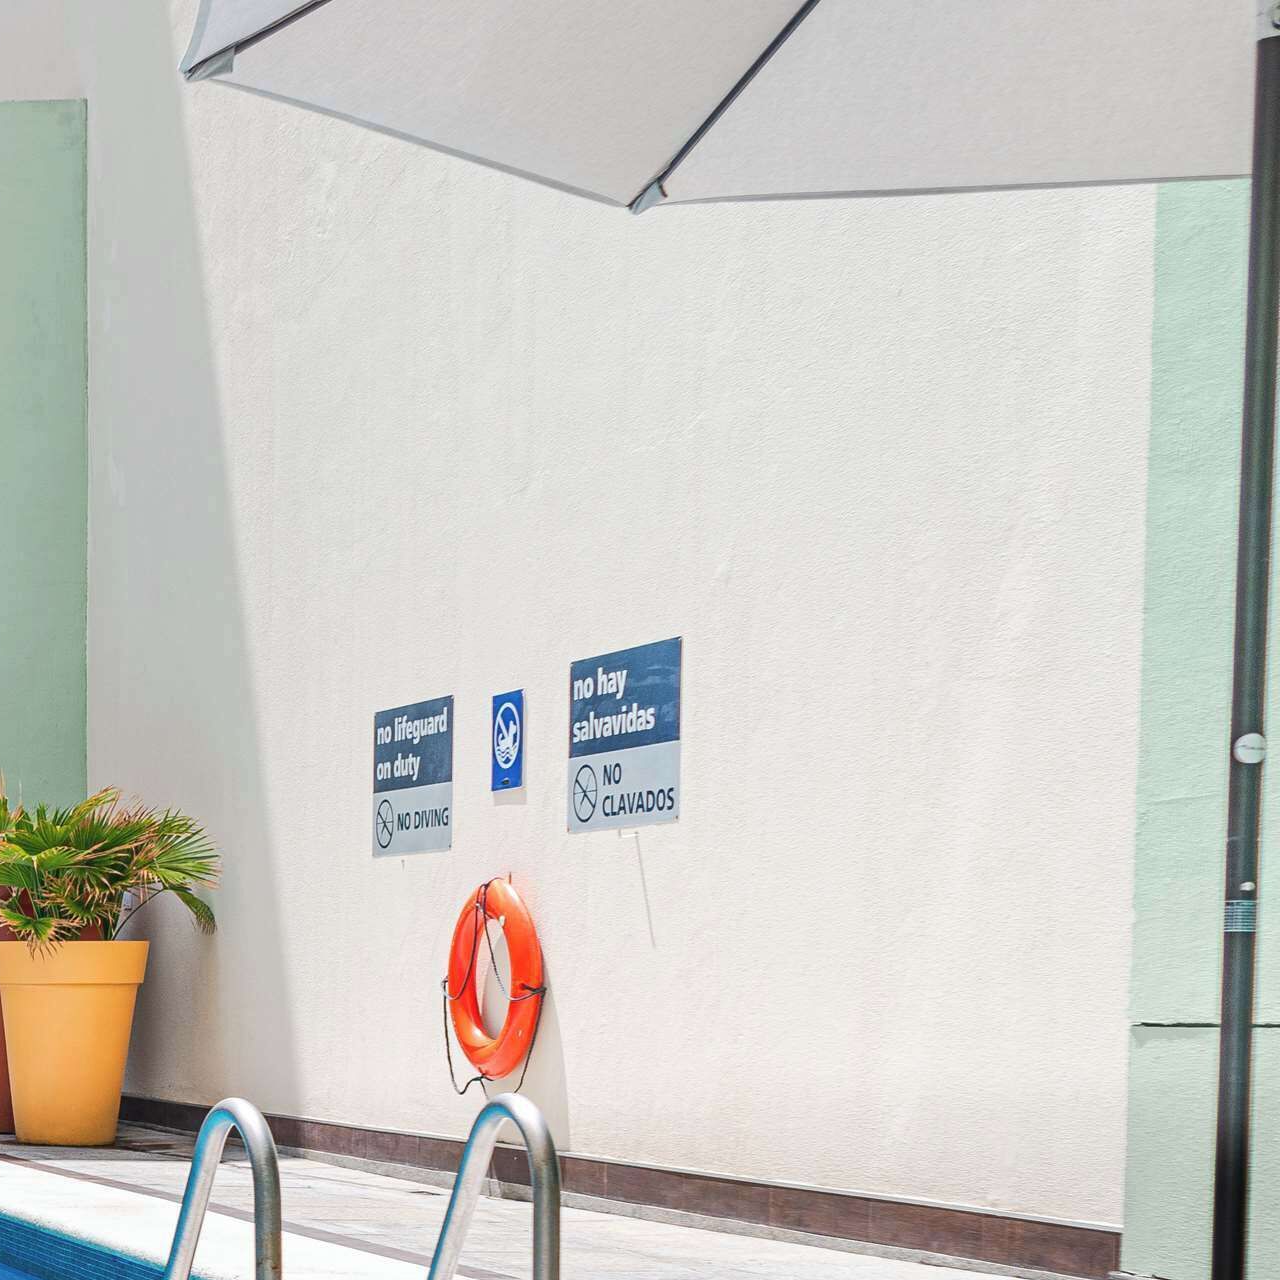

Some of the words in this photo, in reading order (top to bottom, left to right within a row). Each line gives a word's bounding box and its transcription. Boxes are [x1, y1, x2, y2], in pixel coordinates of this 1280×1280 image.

[573, 676, 593, 701] no
[597, 667, 628, 700] hay
[377, 725, 392, 745] no
[394, 707, 448, 745] lifeguard
[572, 702, 656, 744] salvavidas
[377, 761, 391, 781] on
[393, 753, 421, 781] duty
[602, 762, 622, 786] NO
[602, 787, 675, 817] CLAVADOS
[397, 812, 411, 831] NO
[414, 807, 449, 829] DIVING
